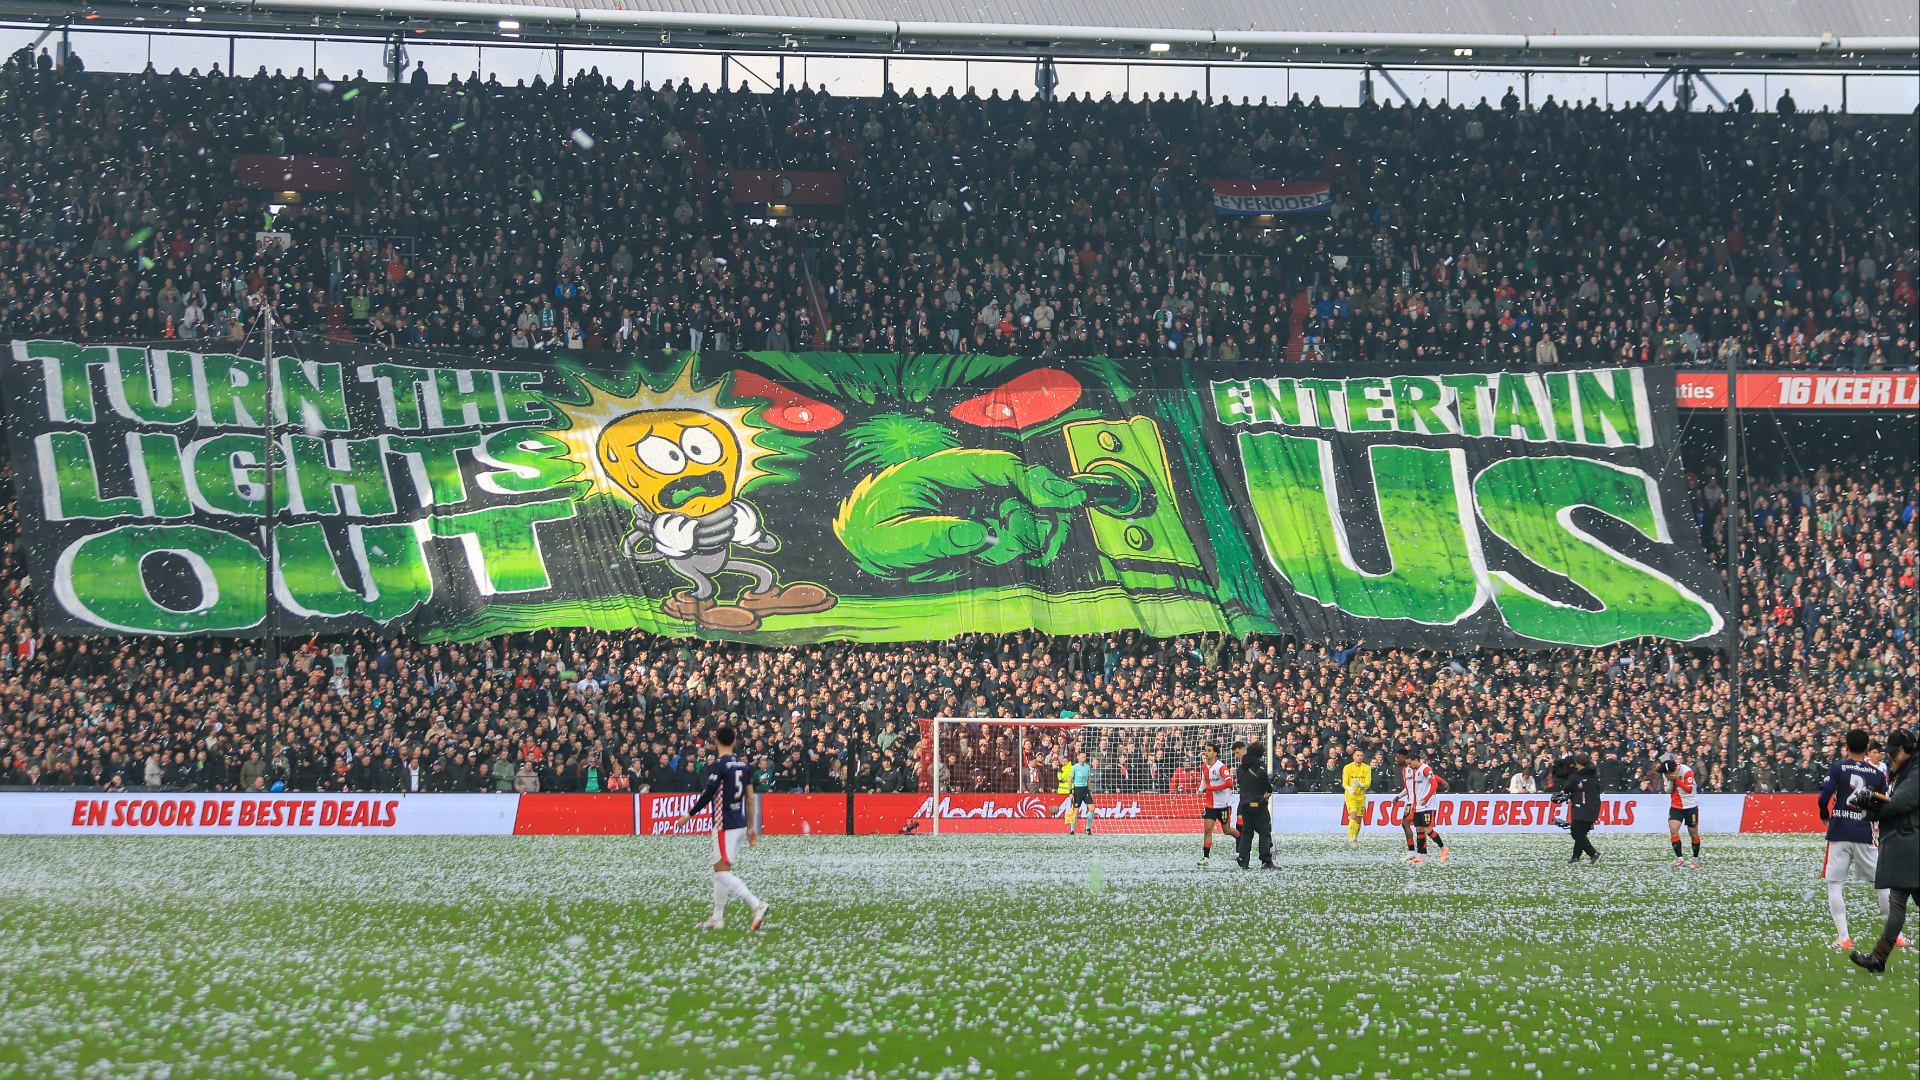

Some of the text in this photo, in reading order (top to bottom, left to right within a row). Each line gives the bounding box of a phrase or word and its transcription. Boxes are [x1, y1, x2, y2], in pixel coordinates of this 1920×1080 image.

[1213, 193, 1329, 211] FEYENOORD
[11, 339, 555, 432] TURN THE
[1777, 376, 1812, 405] 16
[1812, 376, 1892, 405] KEER
[1209, 367, 1654, 448] ENTERTAIN
[35, 425, 590, 520] LIGHTS
[1237, 430, 1724, 647] US
[53, 498, 577, 635] OUT
[734, 769, 744, 800] 5
[1845, 773, 1867, 808] 2
[72, 799, 400, 827] EN SCOOR DE BESTE DEALS
[912, 796, 1014, 819] Media
[1377, 800, 1454, 826] SCR
[1457, 800, 1491, 826] DE
[1492, 800, 1563, 826] BESTE
